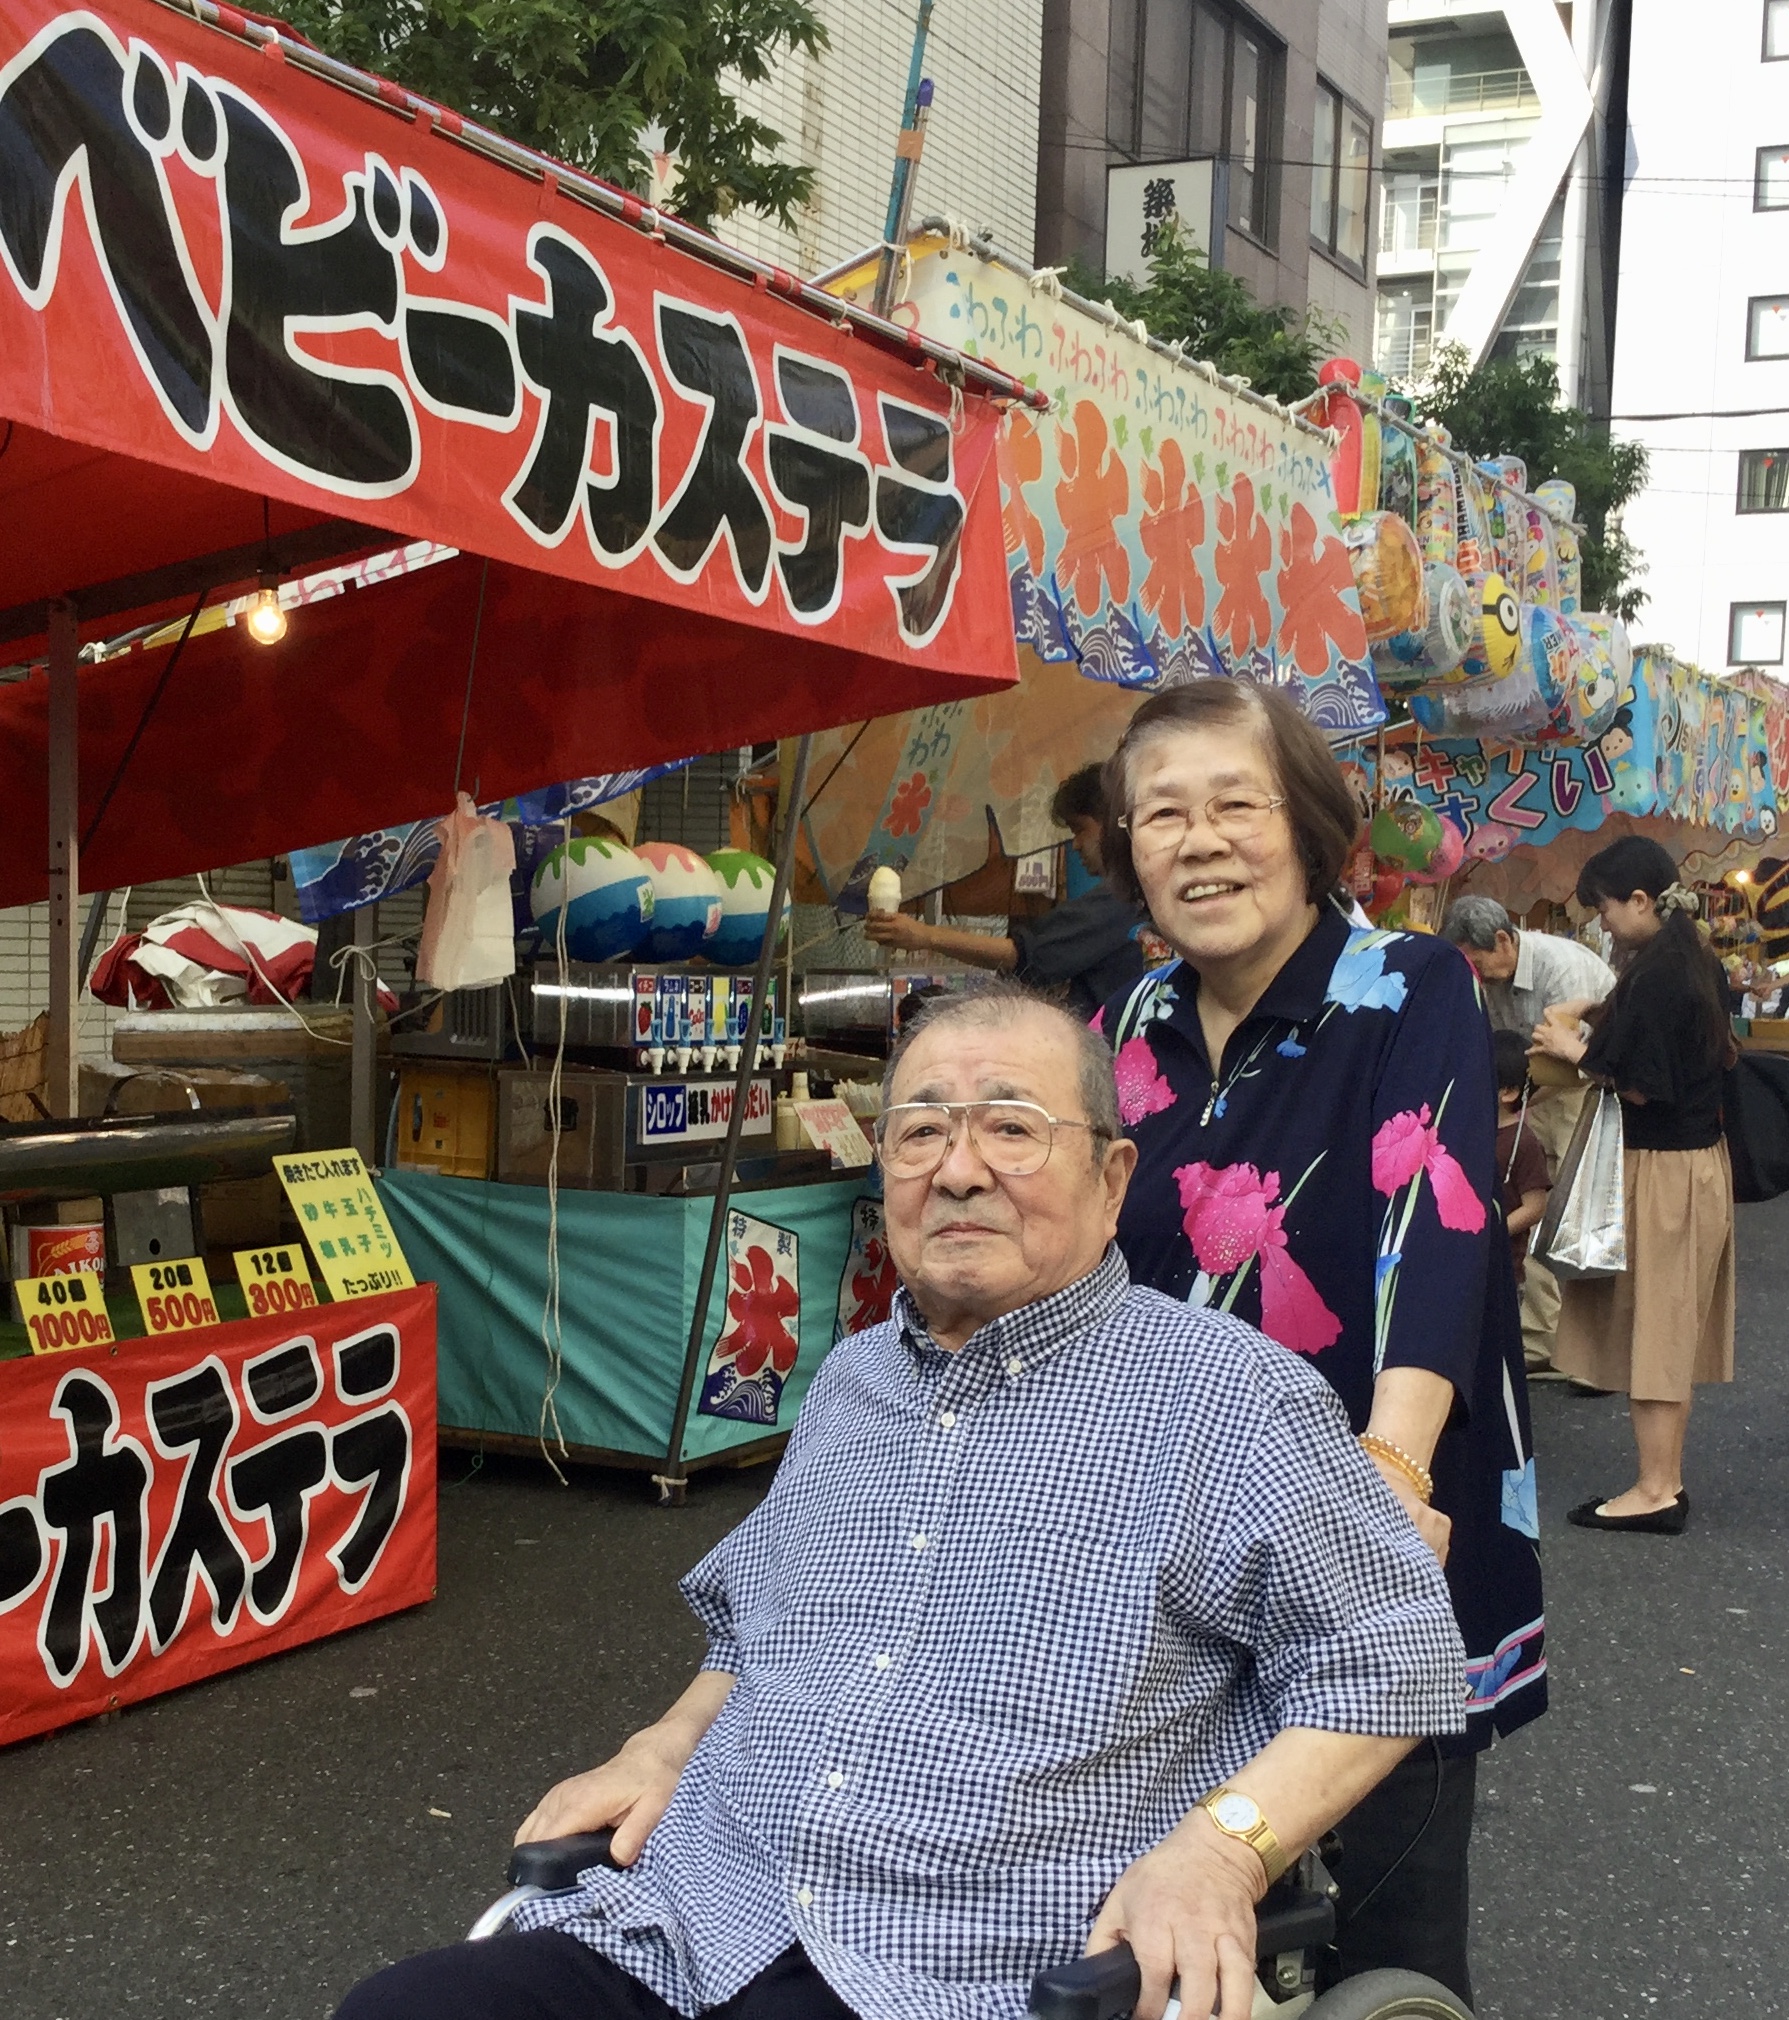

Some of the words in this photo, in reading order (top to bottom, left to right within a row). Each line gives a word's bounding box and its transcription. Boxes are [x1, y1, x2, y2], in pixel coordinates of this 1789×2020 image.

[0, 10, 966, 649] ベビーカステラ
[1050, 322, 1129, 402] ふわふわ
[1136, 367, 1208, 439] ふわふわ
[647, 1090, 685, 1131] シロップ
[146, 1292, 217, 1331] 500円
[248, 1278, 316, 1315] 300円
[716, 1245, 799, 1377] 氷
[29, 1309, 112, 1350] 1000円
